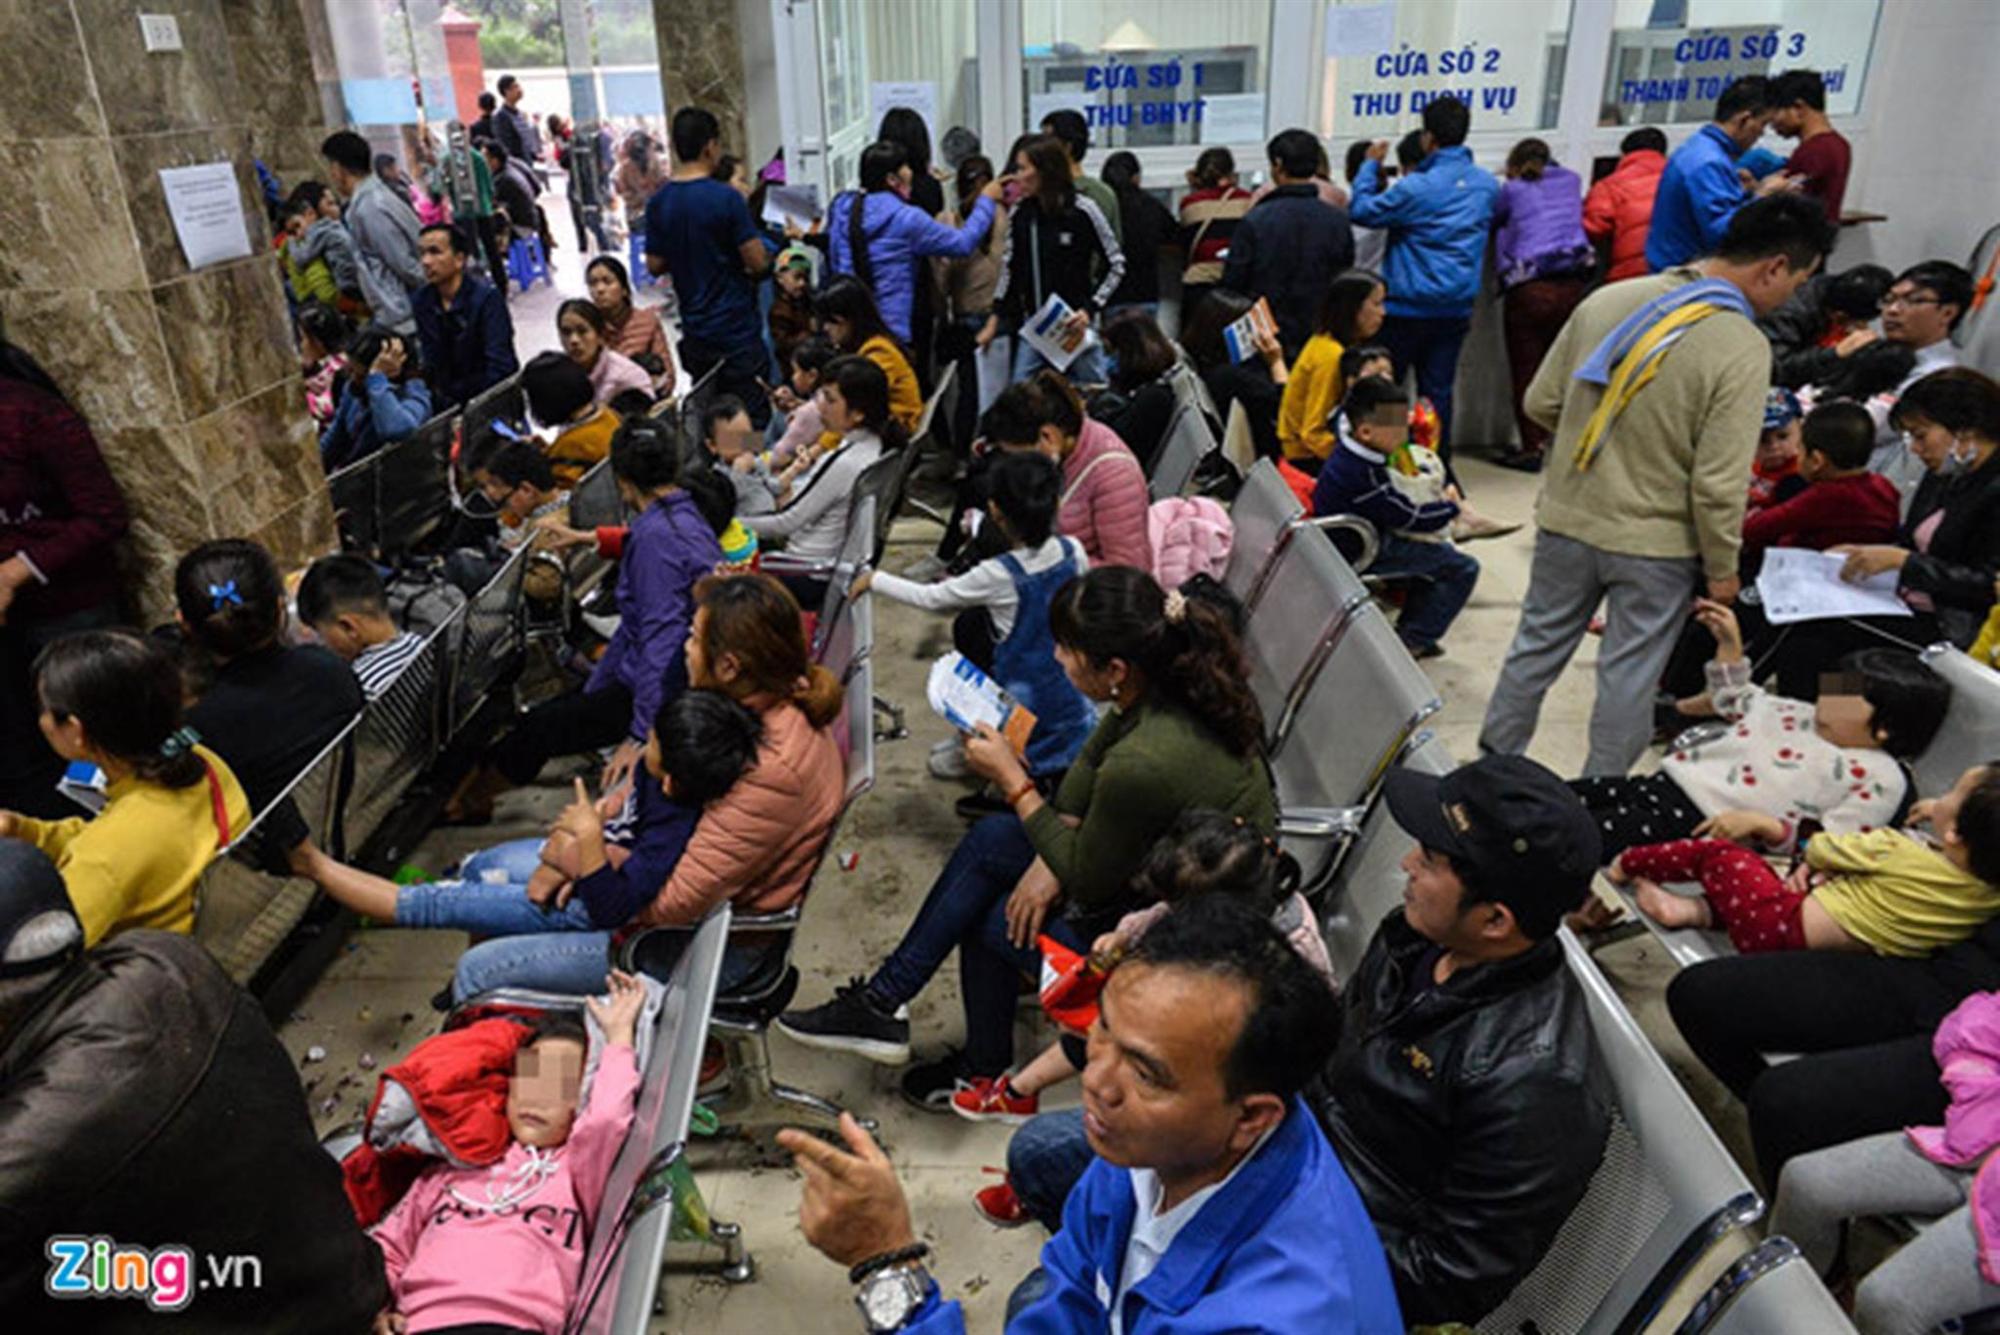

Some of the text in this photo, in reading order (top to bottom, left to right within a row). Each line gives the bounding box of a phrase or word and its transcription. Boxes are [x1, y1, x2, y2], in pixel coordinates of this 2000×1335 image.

[1376, 41, 1501, 78] CỬA SỐ 2
[1674, 29, 1731, 62] CỬA
[1787, 33, 1806, 57] 3
[1084, 55, 1204, 92] CỬA SỐ 1
[1353, 91, 1402, 117] THU
[1482, 86, 1517, 116] VỤ
[1622, 79, 1690, 104] THANH
[1084, 103, 1133, 128] THU
[1142, 98, 1207, 126] BHYT
